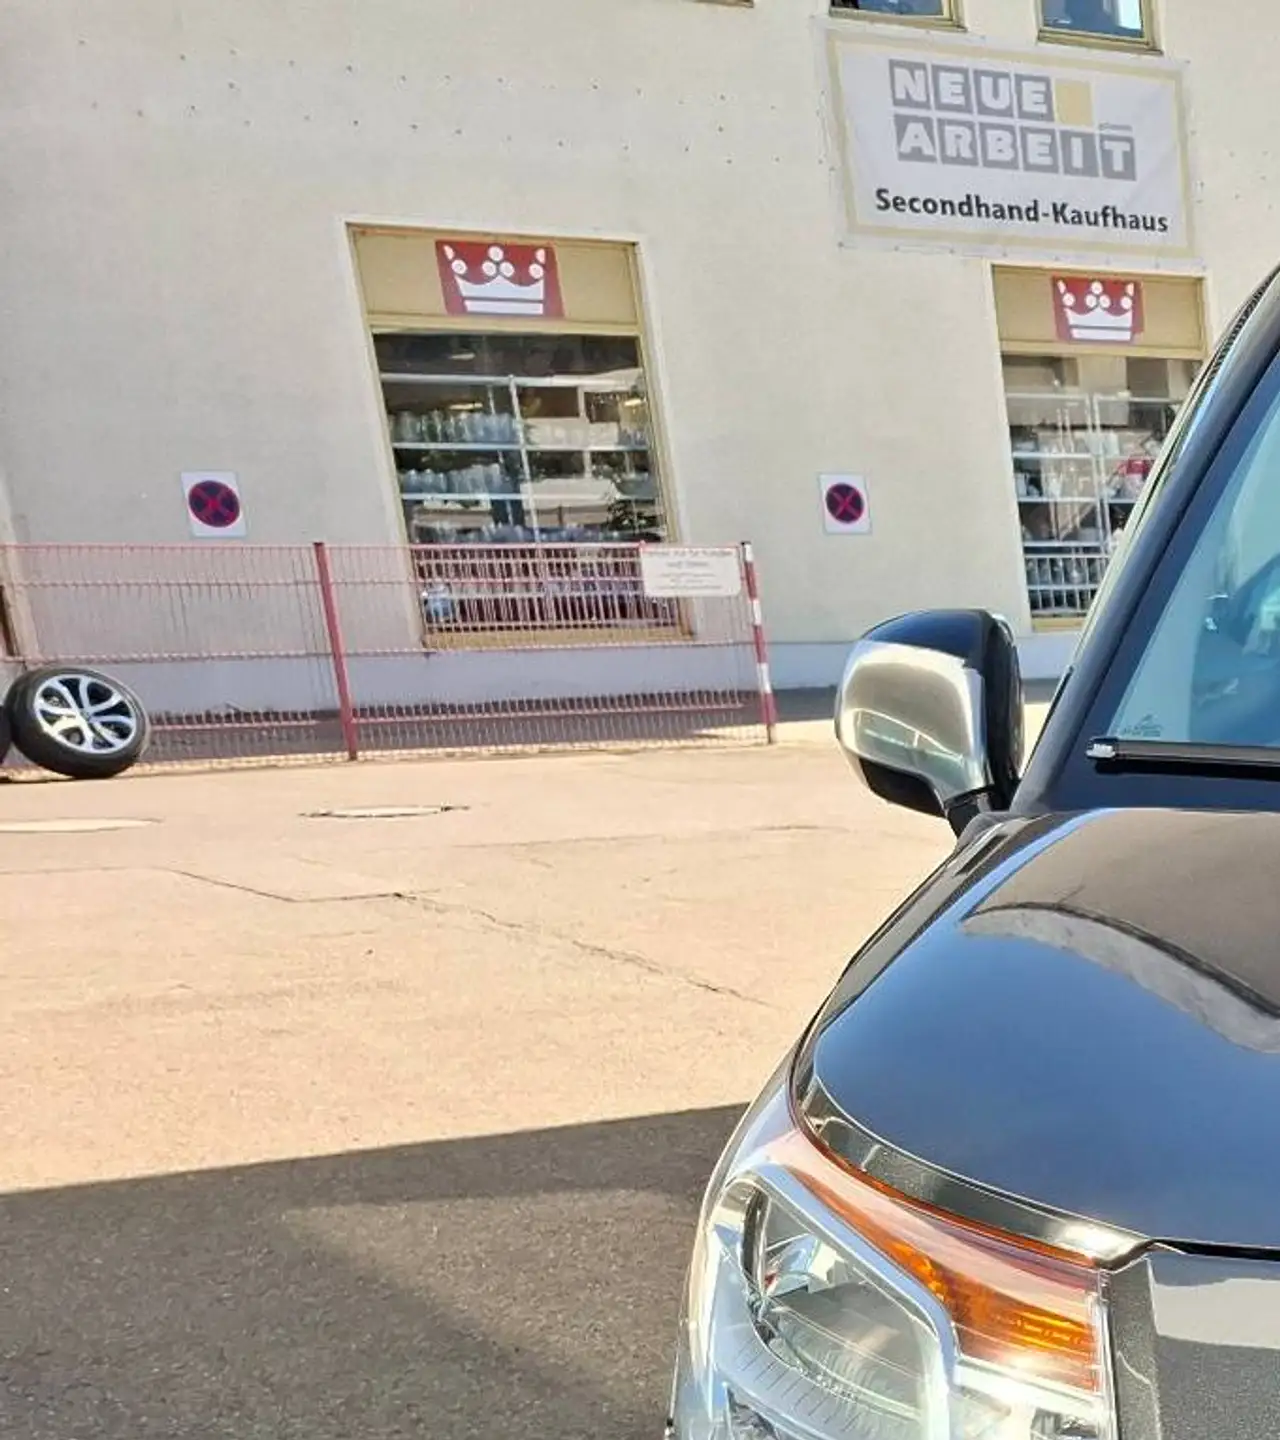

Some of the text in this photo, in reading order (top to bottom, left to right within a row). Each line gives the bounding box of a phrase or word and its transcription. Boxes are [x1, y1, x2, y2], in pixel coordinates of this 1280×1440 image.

[890, 64, 1049, 116] NEUE
[897, 120, 1135, 175] ARBEIT
[875, 187, 1169, 233] Secondhand-Kaufhaus
